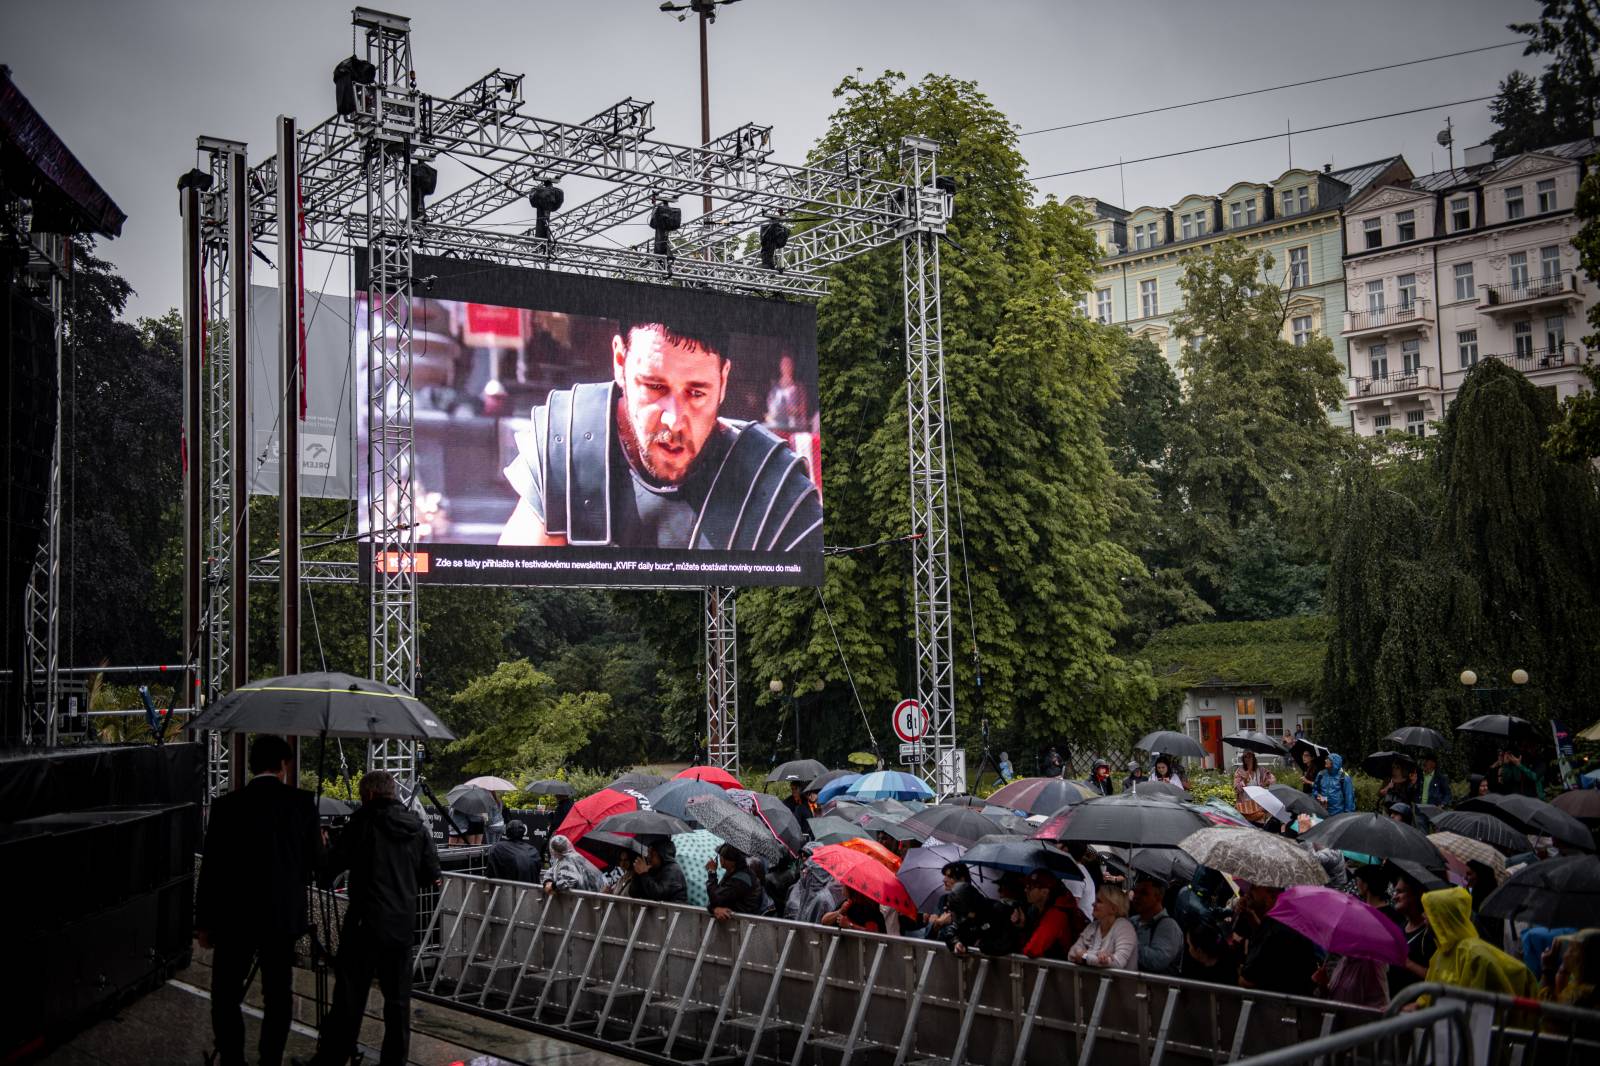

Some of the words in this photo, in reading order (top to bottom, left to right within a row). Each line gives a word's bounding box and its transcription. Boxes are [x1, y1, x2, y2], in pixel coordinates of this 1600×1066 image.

[435, 558, 452, 568] Zde
[453, 559, 463, 568] se
[464, 558, 481, 569] taky
[521, 559, 570, 569] festivalovému
[571, 560, 612, 570] newsletteru
[638, 561, 654, 572] daily
[675, 561, 699, 571] můžete
[700, 562, 728, 572] dostávat
[729, 562, 753, 574] novinky
[753, 563, 775, 573] rovnou
[775, 563, 784, 573] do
[785, 563, 801, 573] mailu
